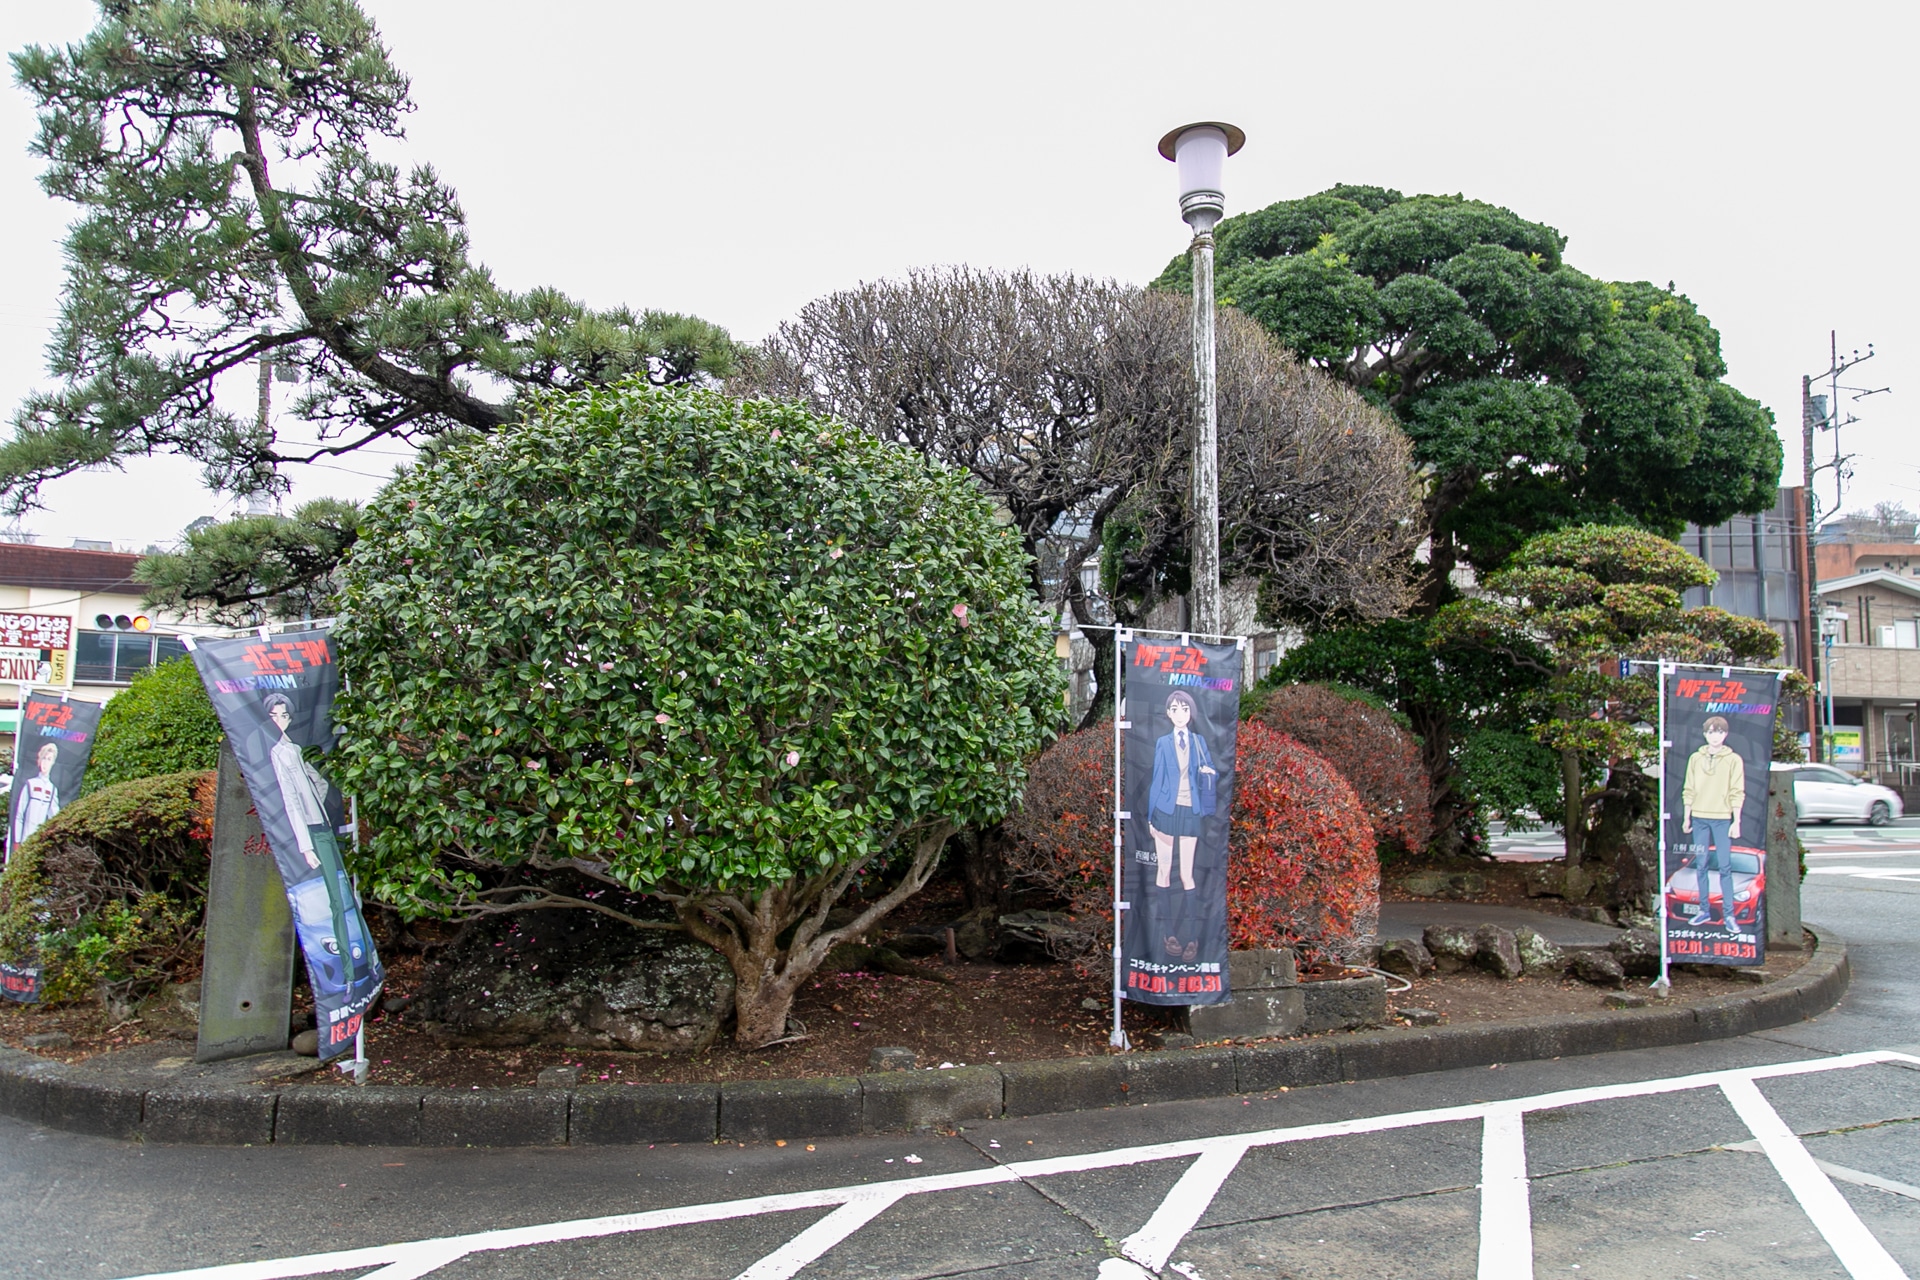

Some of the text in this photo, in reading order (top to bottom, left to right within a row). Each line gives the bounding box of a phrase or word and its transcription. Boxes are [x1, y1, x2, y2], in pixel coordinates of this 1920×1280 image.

[55, 654, 64, 680] こちら
[1168, 673, 1233, 691] MANAZURU
[1705, 702, 1771, 714] MANAZURU
